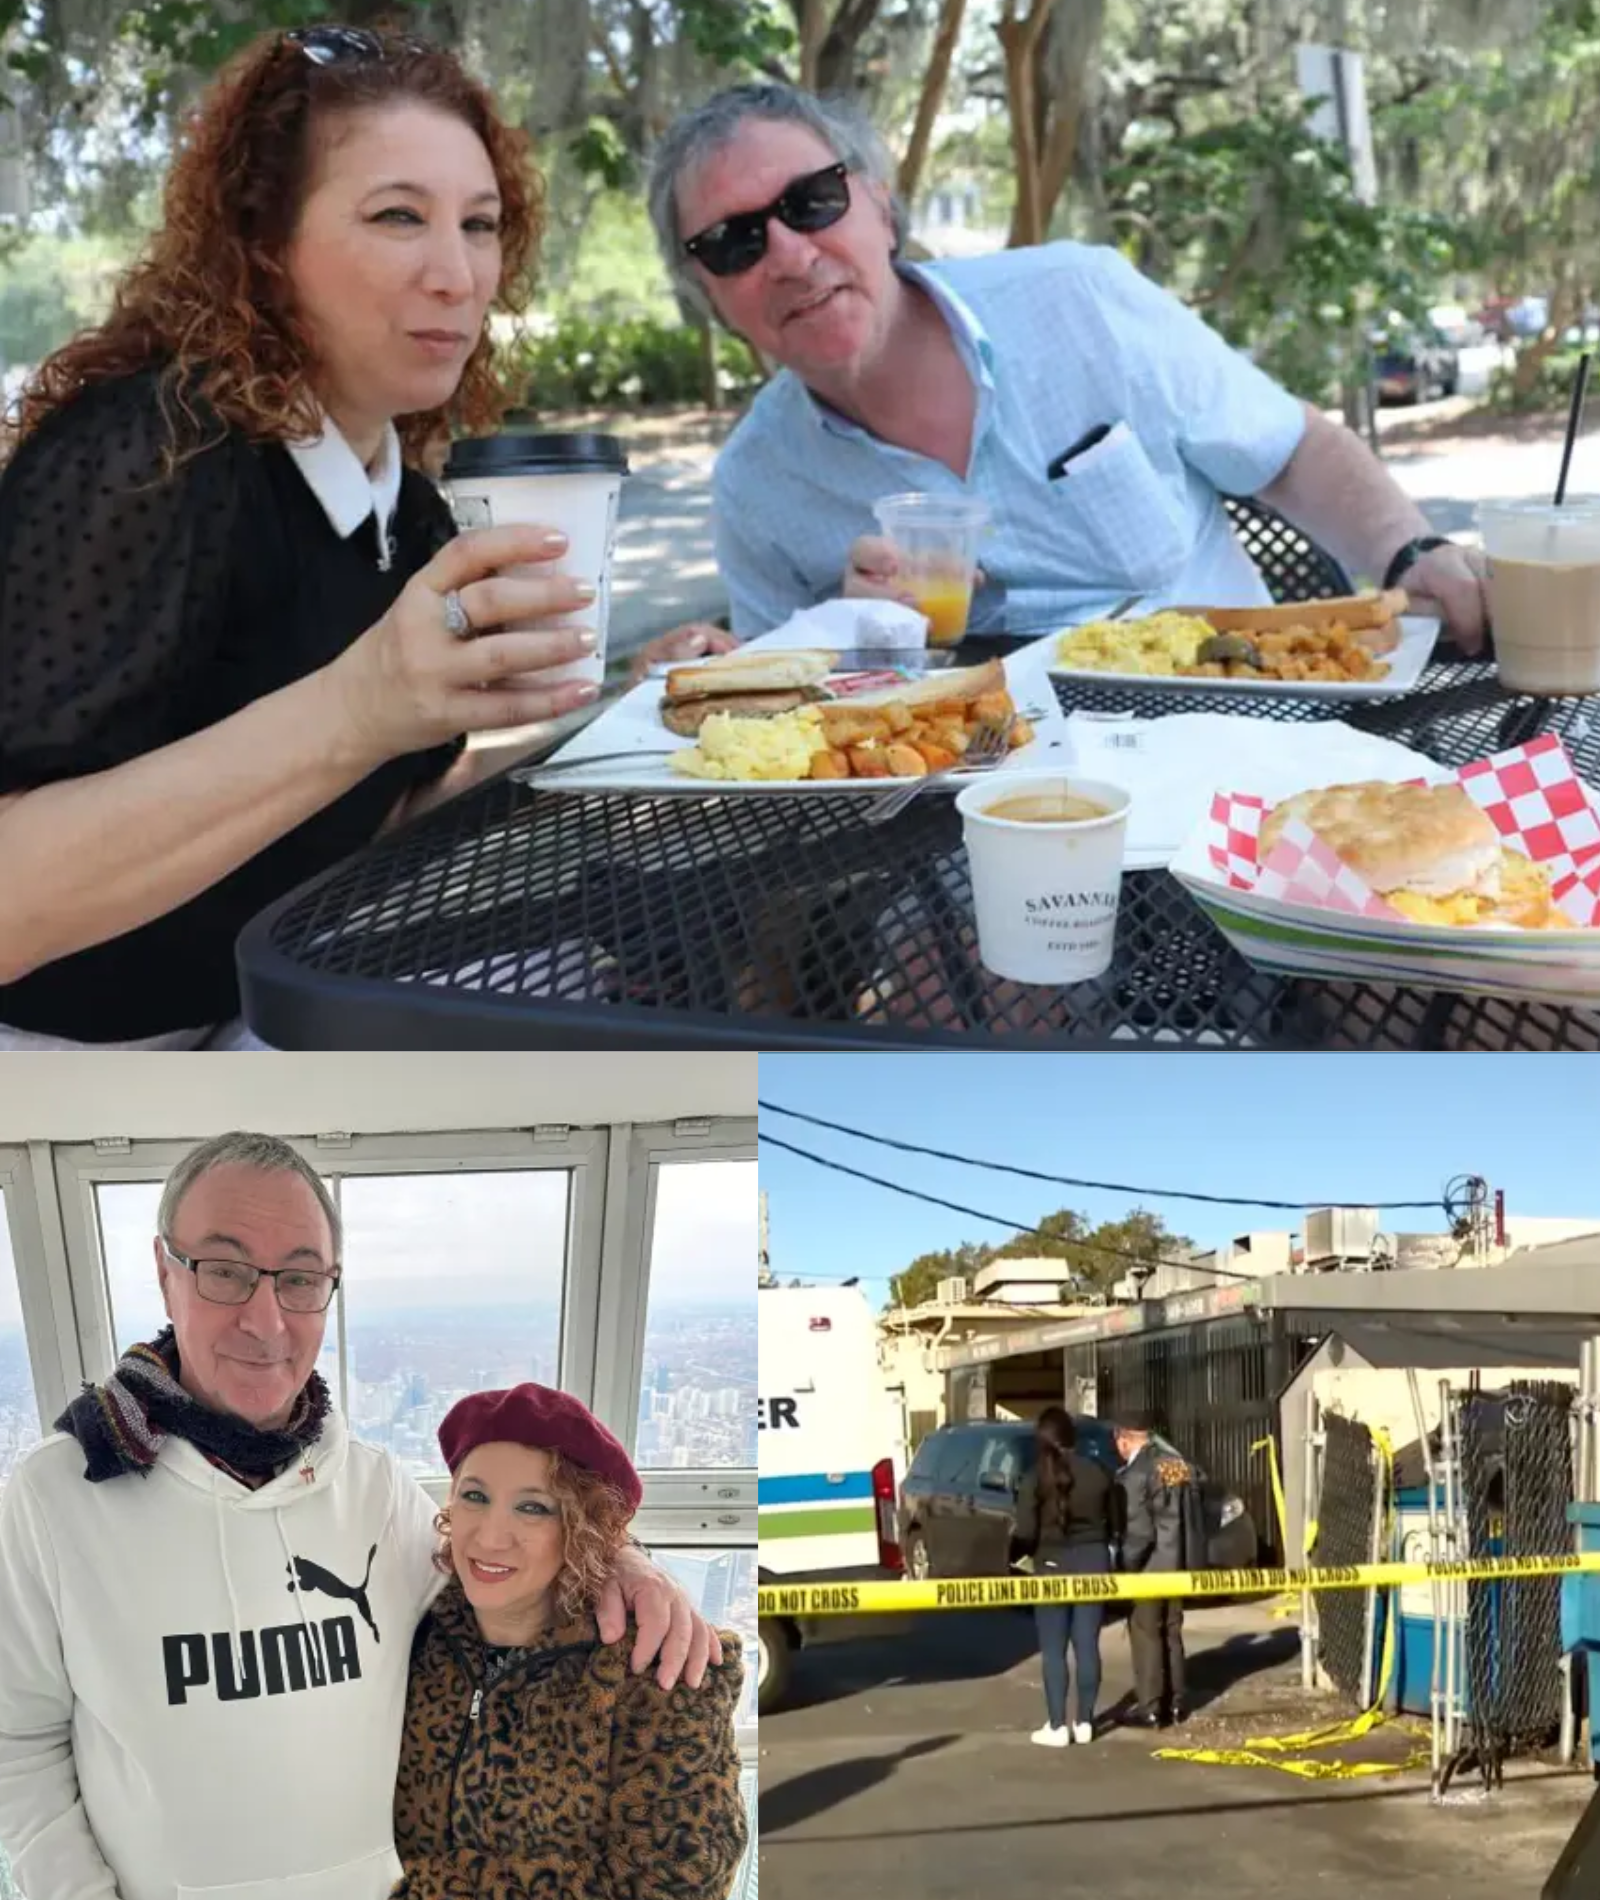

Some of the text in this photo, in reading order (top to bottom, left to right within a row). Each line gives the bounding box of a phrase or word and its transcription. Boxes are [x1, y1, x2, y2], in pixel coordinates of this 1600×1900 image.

[936, 1575, 1119, 1604] POLICE LINE DO NOT CROSS
[1190, 1571, 1236, 1592] POLICE
[1239, 1569, 1266, 1588] LINE
[1290, 1567, 1313, 1585] NOT
[1318, 1567, 1360, 1582] CROSS
[779, 1588, 806, 1611] NOT
[811, 1586, 860, 1609] CROSS
[162, 1615, 362, 1705] PUMA
